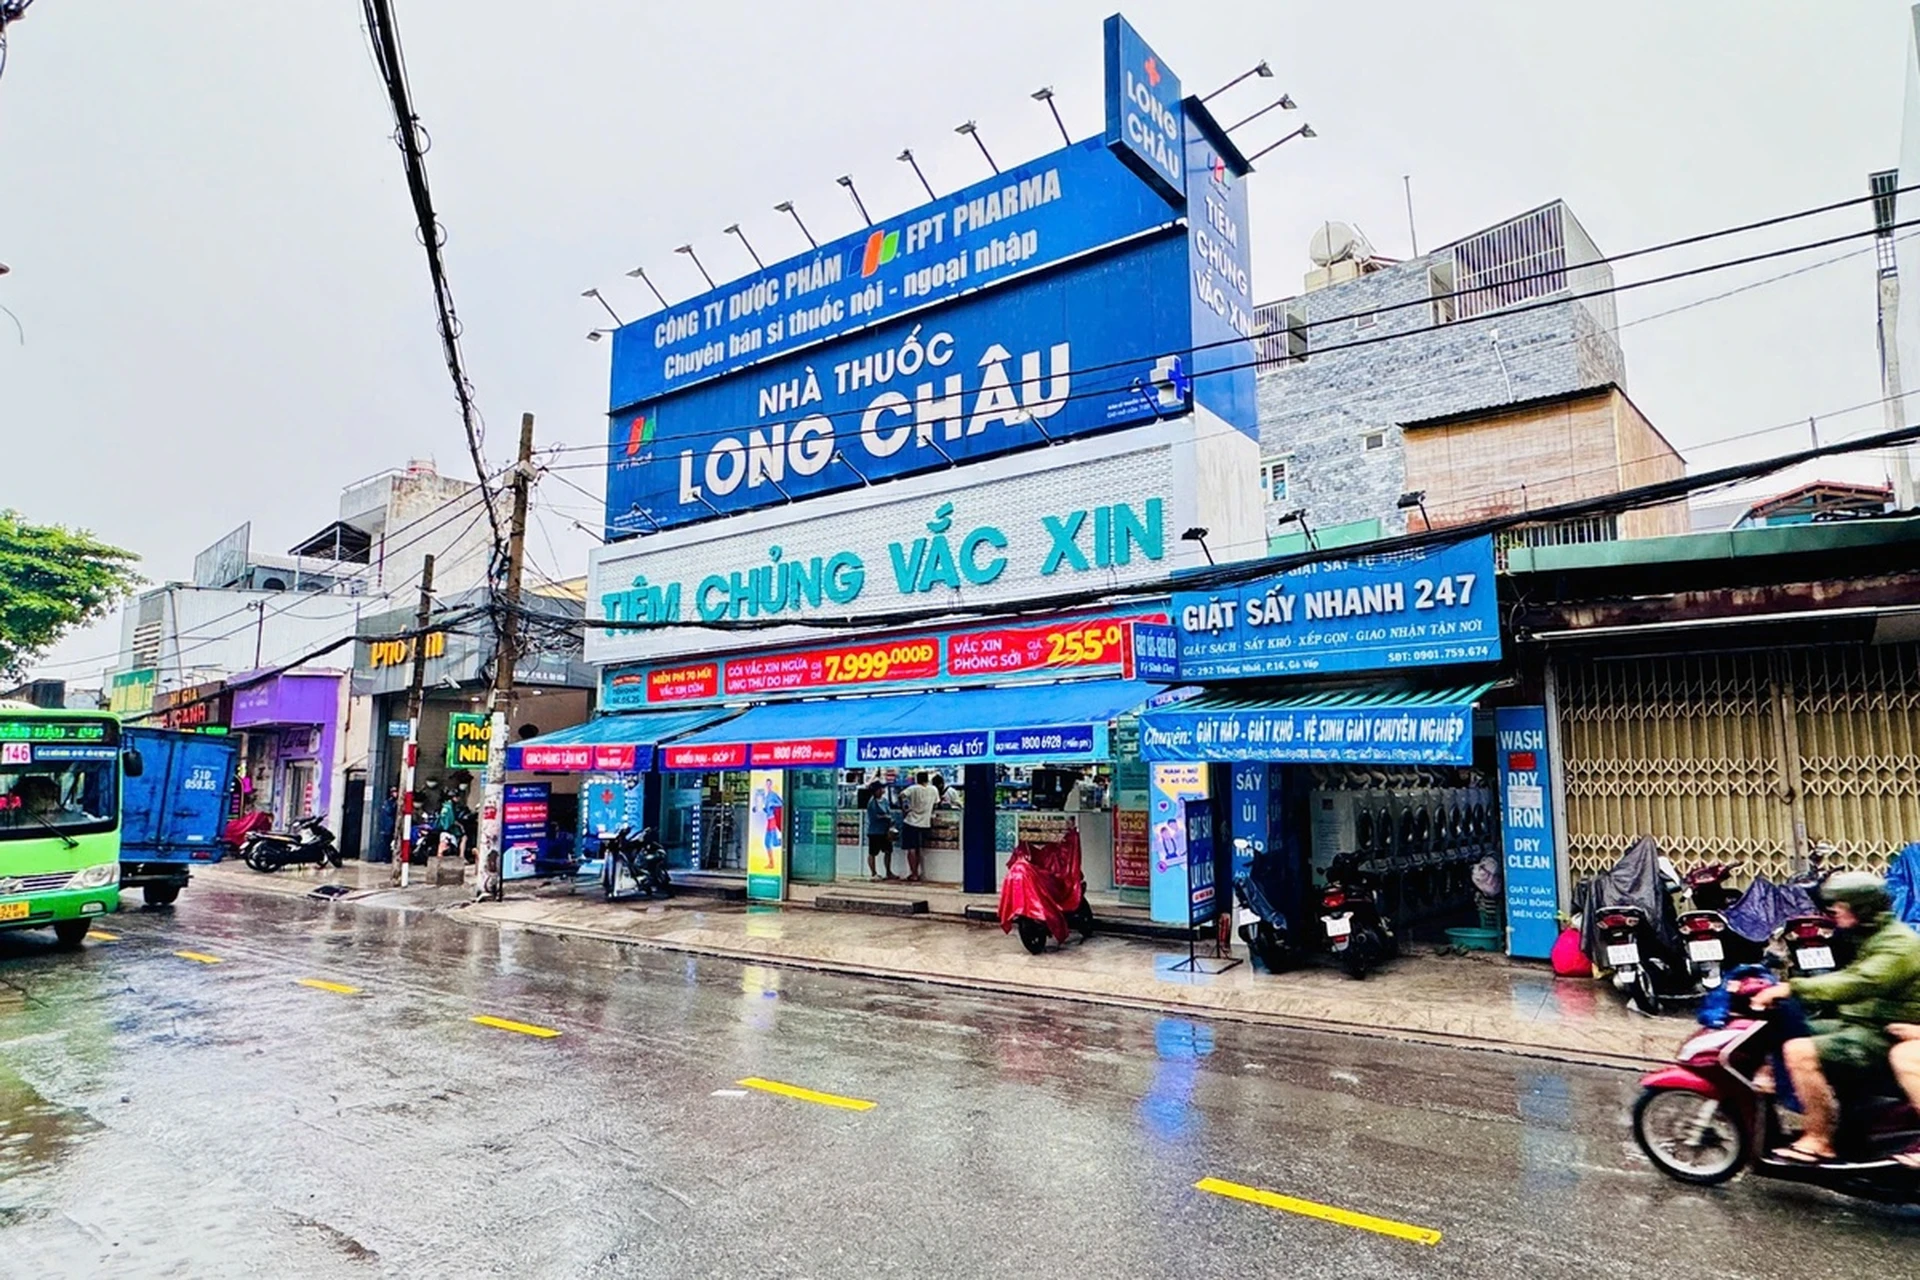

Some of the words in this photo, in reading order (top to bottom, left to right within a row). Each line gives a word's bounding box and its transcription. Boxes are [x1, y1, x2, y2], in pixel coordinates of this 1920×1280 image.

[1127, 70, 1177, 140] LONG
[1127, 113, 1179, 179] CHÂU
[1205, 196, 1237, 248] TIÊM
[655, 310, 699, 349] CÔNG
[704, 299, 725, 330] TY
[729, 278, 779, 321] DƯỢC
[785, 252, 842, 300] PHẨM
[906, 212, 946, 254] FPT
[953, 168, 1062, 237] PHARMA
[1196, 230, 1247, 296] CHỦNG
[664, 342, 725, 380] Chuyên
[729, 328, 762, 357] bán
[788, 295, 844, 337] thuốc
[850, 281, 883, 315] nội
[903, 250, 967, 298] ngoại
[975, 229, 1038, 273] nhập
[1194, 268, 1225, 316] VẮC
[1228, 300, 1251, 338] XIN
[759, 367, 822, 418] NHÀ
[835, 324, 954, 392] THUỐC
[679, 413, 836, 504] LONG
[860, 343, 1071, 457] CHÂU
[602, 575, 681, 637] TIÊM
[696, 545, 865, 624] CHỦNG
[888, 503, 1008, 595] VẮC
[1040, 498, 1164, 575] XIN
[1182, 595, 1237, 637] GIẶT
[1246, 583, 1296, 625] SẤY
[1304, 582, 1405, 620] NHANH
[1414, 574, 1477, 609] 247
[954, 637, 978, 654] VẮC
[981, 638, 1002, 651] XIN
[1243, 635, 1265, 650] SẤY
[1298, 630, 1322, 646] XẾP
[1323, 632, 1348, 646] GỌN
[1356, 629, 1386, 641] GIAO
[1390, 625, 1426, 639] NHẬN
[1430, 622, 1456, 637] TẬN
[745, 660, 763, 674] VẮC
[764, 661, 780, 672] XIN
[954, 653, 999, 670] PHÒNG
[1198, 665, 1214, 676] 292
[1216, 662, 1240, 675] Thống
[1414, 646, 1488, 660] 0901.759.674
[768, 675, 783, 686] DO
[784, 674, 804, 685] HPV
[1021, 736, 1041, 749] 1800
[1042, 735, 1061, 748] 6928
[1144, 726, 1193, 748] Chuyên:
[1318, 718, 1344, 742] SINH
[1346, 712, 1372, 742] GIÀY
[1373, 712, 1417, 742] CHUYÊN
[1419, 712, 1464, 746] NGHIỆP
[1500, 730, 1544, 750] WASH
[5, 745, 28, 761] 146
[860, 741, 877, 759] VẮC
[949, 741, 963, 755] GIÁ
[965, 737, 984, 755] TỐT
[1236, 766, 1262, 791] SẤY
[1508, 771, 1539, 787] DRY
[1242, 798, 1256, 823] ỦI
[1508, 807, 1544, 828] IRON
[1514, 838, 1541, 852] DRY
[1508, 855, 1550, 869] CLEAN
